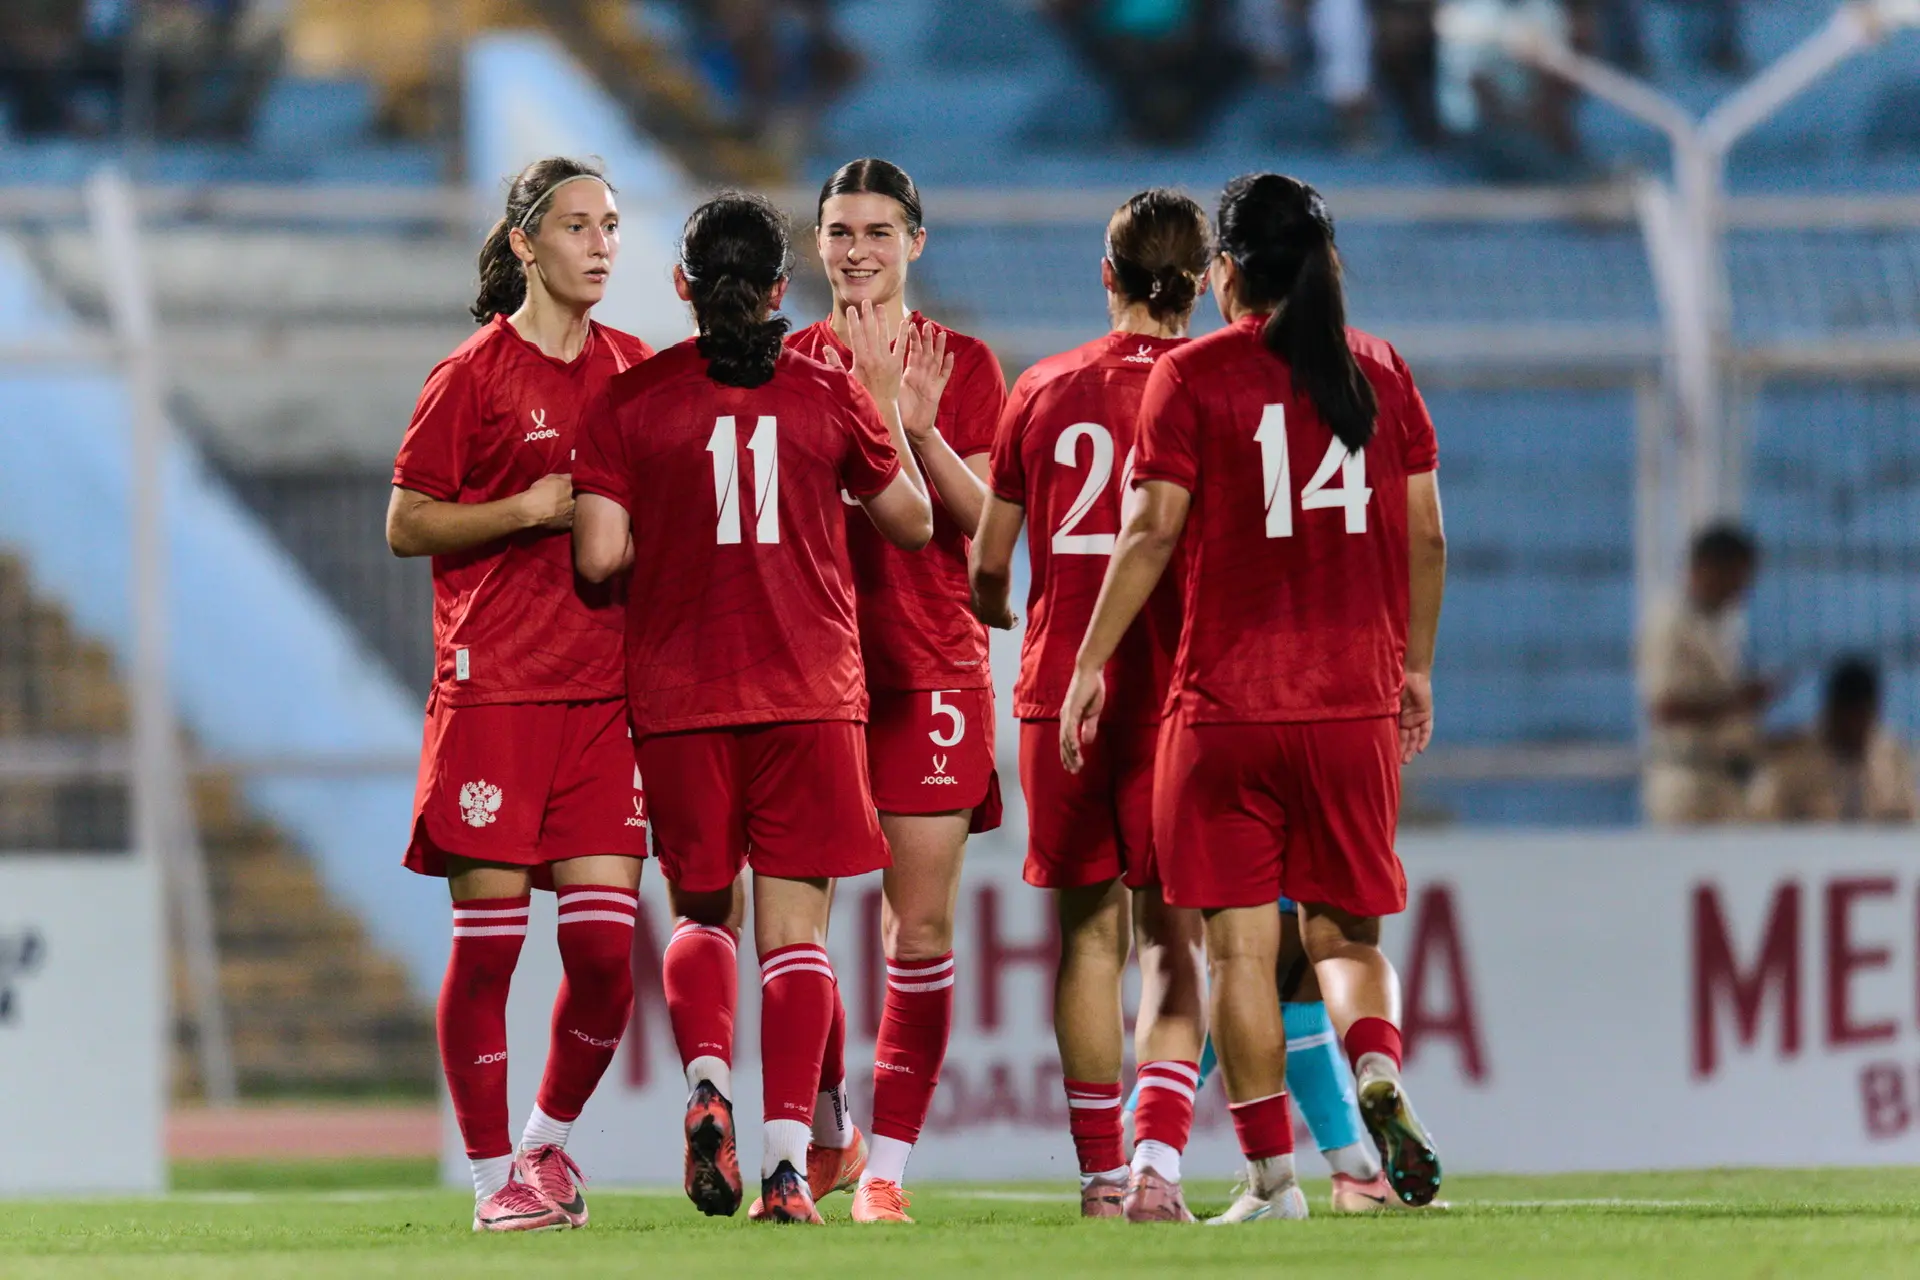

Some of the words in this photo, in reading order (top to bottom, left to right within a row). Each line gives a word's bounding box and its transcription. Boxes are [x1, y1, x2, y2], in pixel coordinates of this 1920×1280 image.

[706, 415, 780, 545] 11
[1253, 403, 1373, 539] 14
[928, 690, 966, 747] 5
[1692, 873, 1920, 1082] ME
[1859, 1060, 1920, 1142] B
